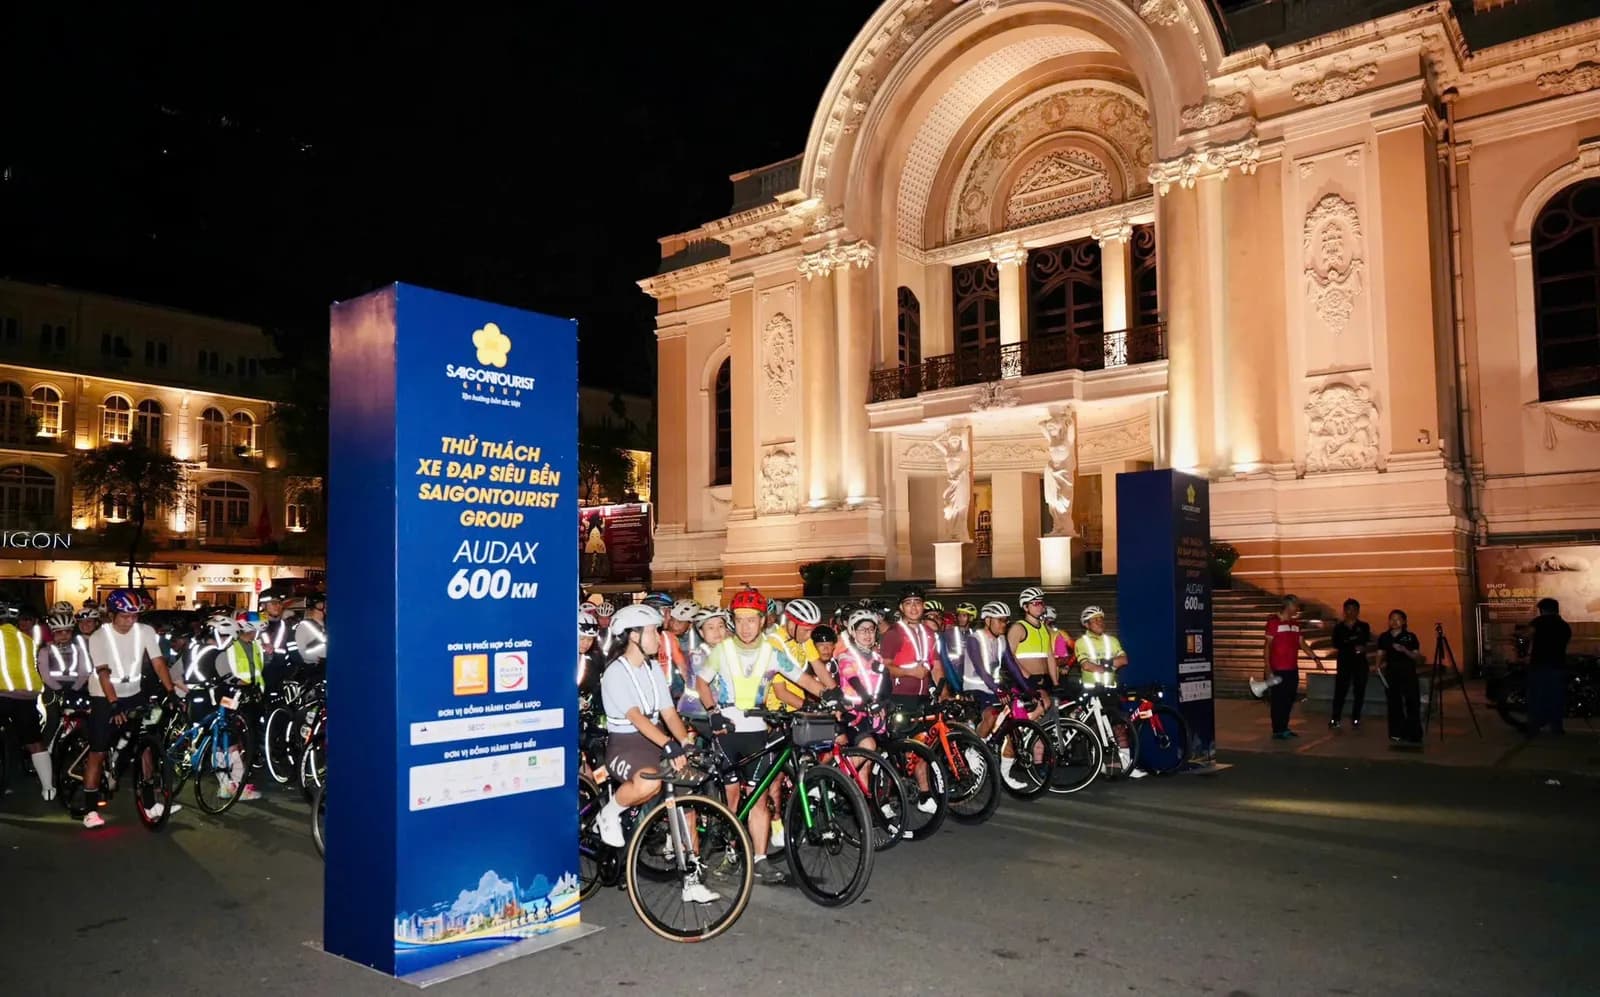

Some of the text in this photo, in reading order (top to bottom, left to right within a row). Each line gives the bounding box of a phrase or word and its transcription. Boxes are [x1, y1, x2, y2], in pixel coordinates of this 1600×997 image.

[446, 364, 535, 390] SAIGONTOURIST
[462, 381, 521, 397] GROUP
[441, 434, 541, 462] THỬ THÁCH
[416, 458, 561, 486] XE ĐẠP SIÊU BỀN
[418, 483, 560, 508] SAIGONTOURIST
[460, 510, 524, 528] GROUP
[452, 540, 539, 564] AUDAX
